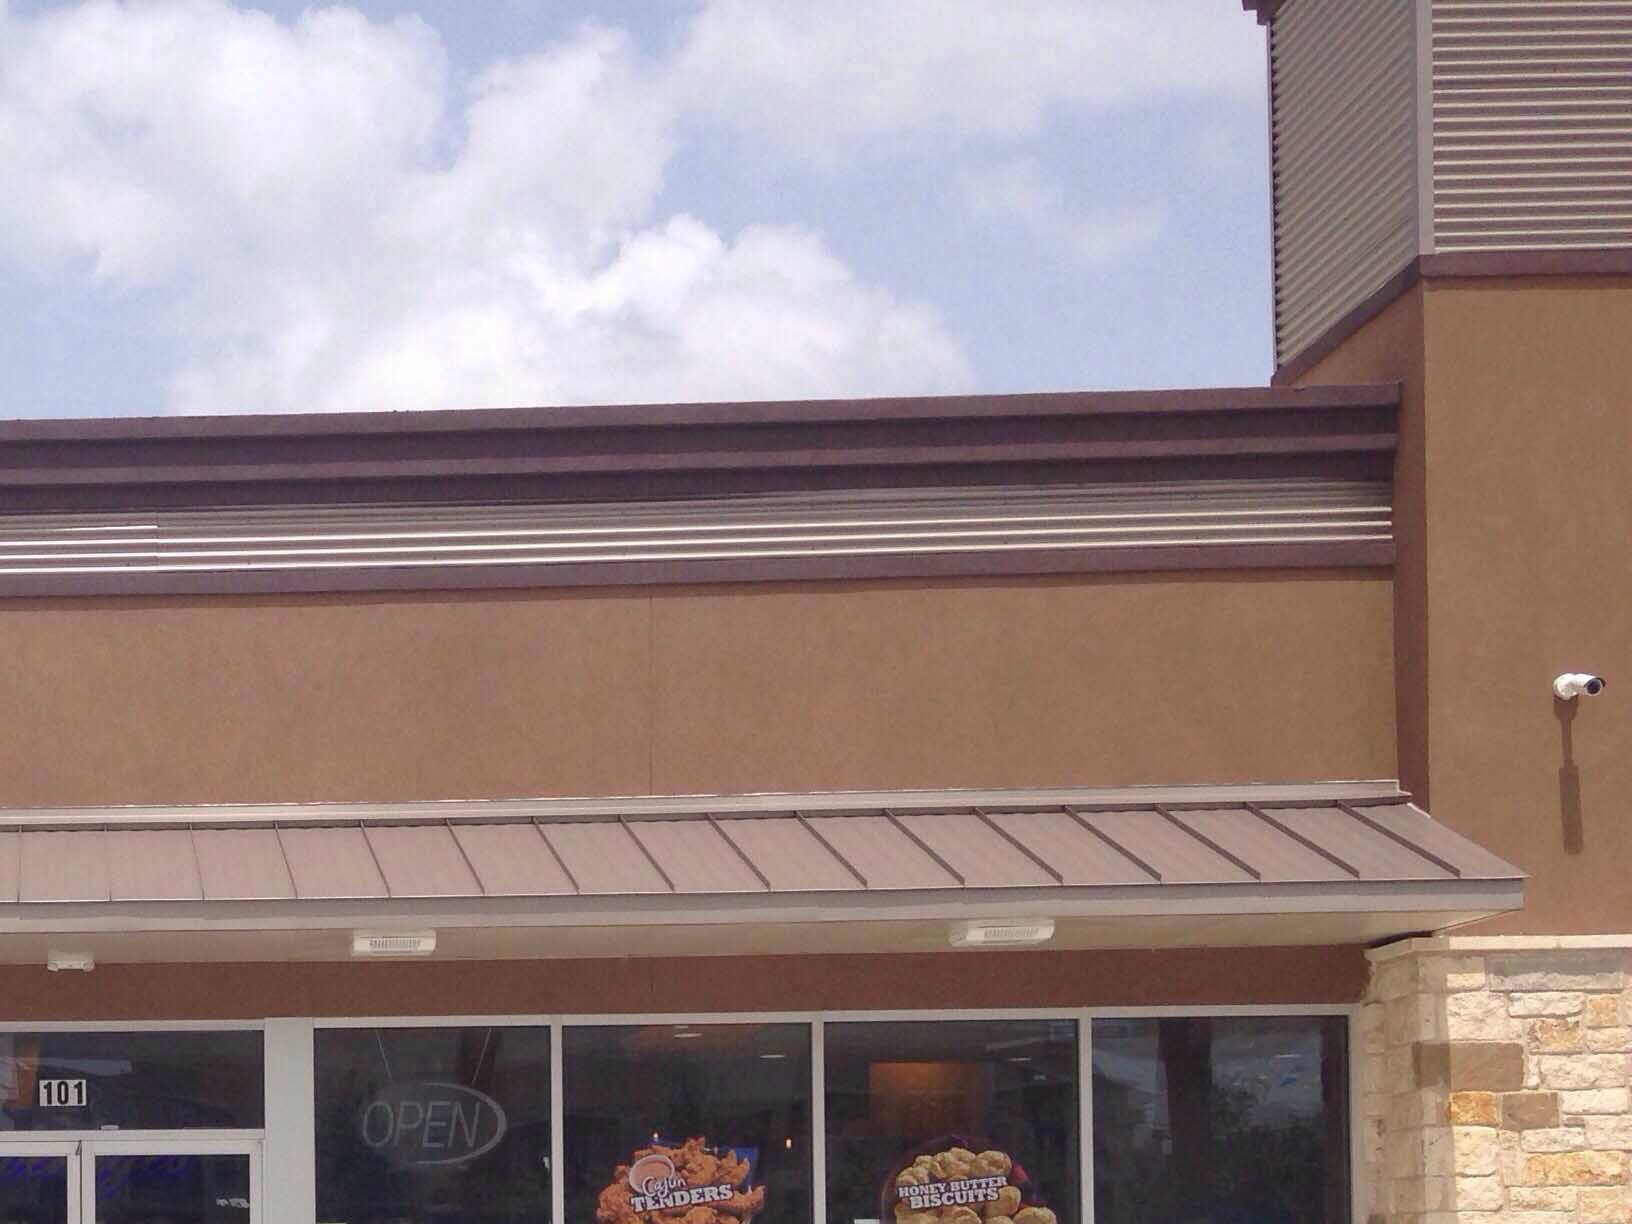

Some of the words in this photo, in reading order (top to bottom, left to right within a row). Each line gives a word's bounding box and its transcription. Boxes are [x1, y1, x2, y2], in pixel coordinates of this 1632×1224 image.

[43, 1081, 83, 1105] 101
[363, 1101, 481, 1148] OPEN
[630, 1184, 734, 1212] TENDERS
[642, 1175, 686, 1198] Cajun
[898, 1183, 946, 1198] HONEY
[951, 1176, 1008, 1192] BUTTER
[910, 1187, 999, 1209] BISCUITS
